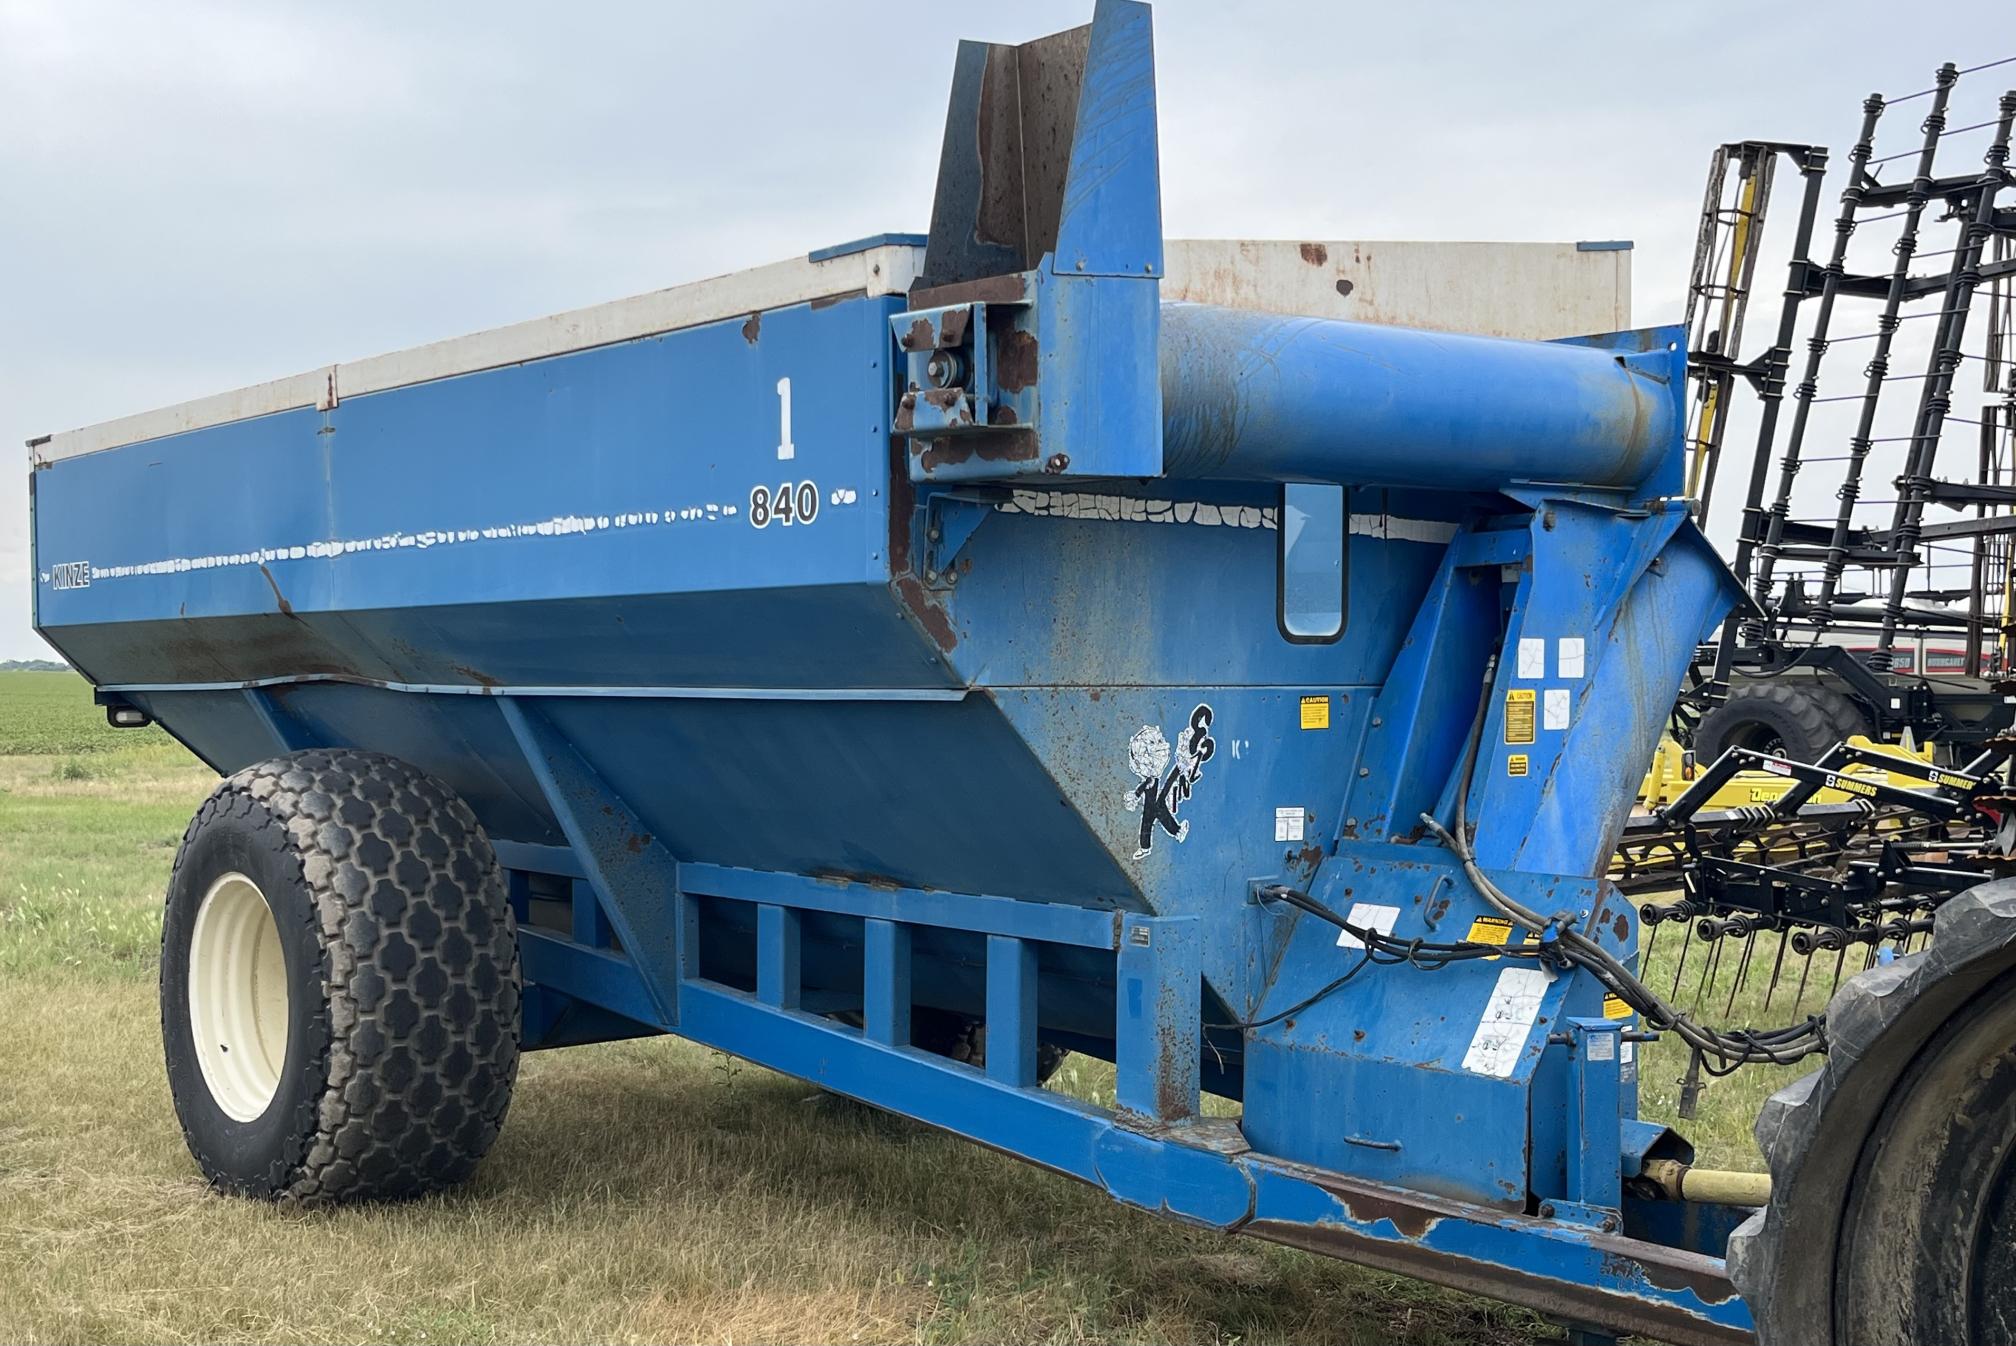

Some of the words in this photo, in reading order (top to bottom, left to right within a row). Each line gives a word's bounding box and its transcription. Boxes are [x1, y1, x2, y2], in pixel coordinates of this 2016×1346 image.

[777, 377, 795, 460] 1
[750, 480, 819, 529] 840
[53, 561, 90, 590] KINZE
[1835, 777, 1878, 798] SUMMERS
[1938, 773, 1977, 791] SUMMER
